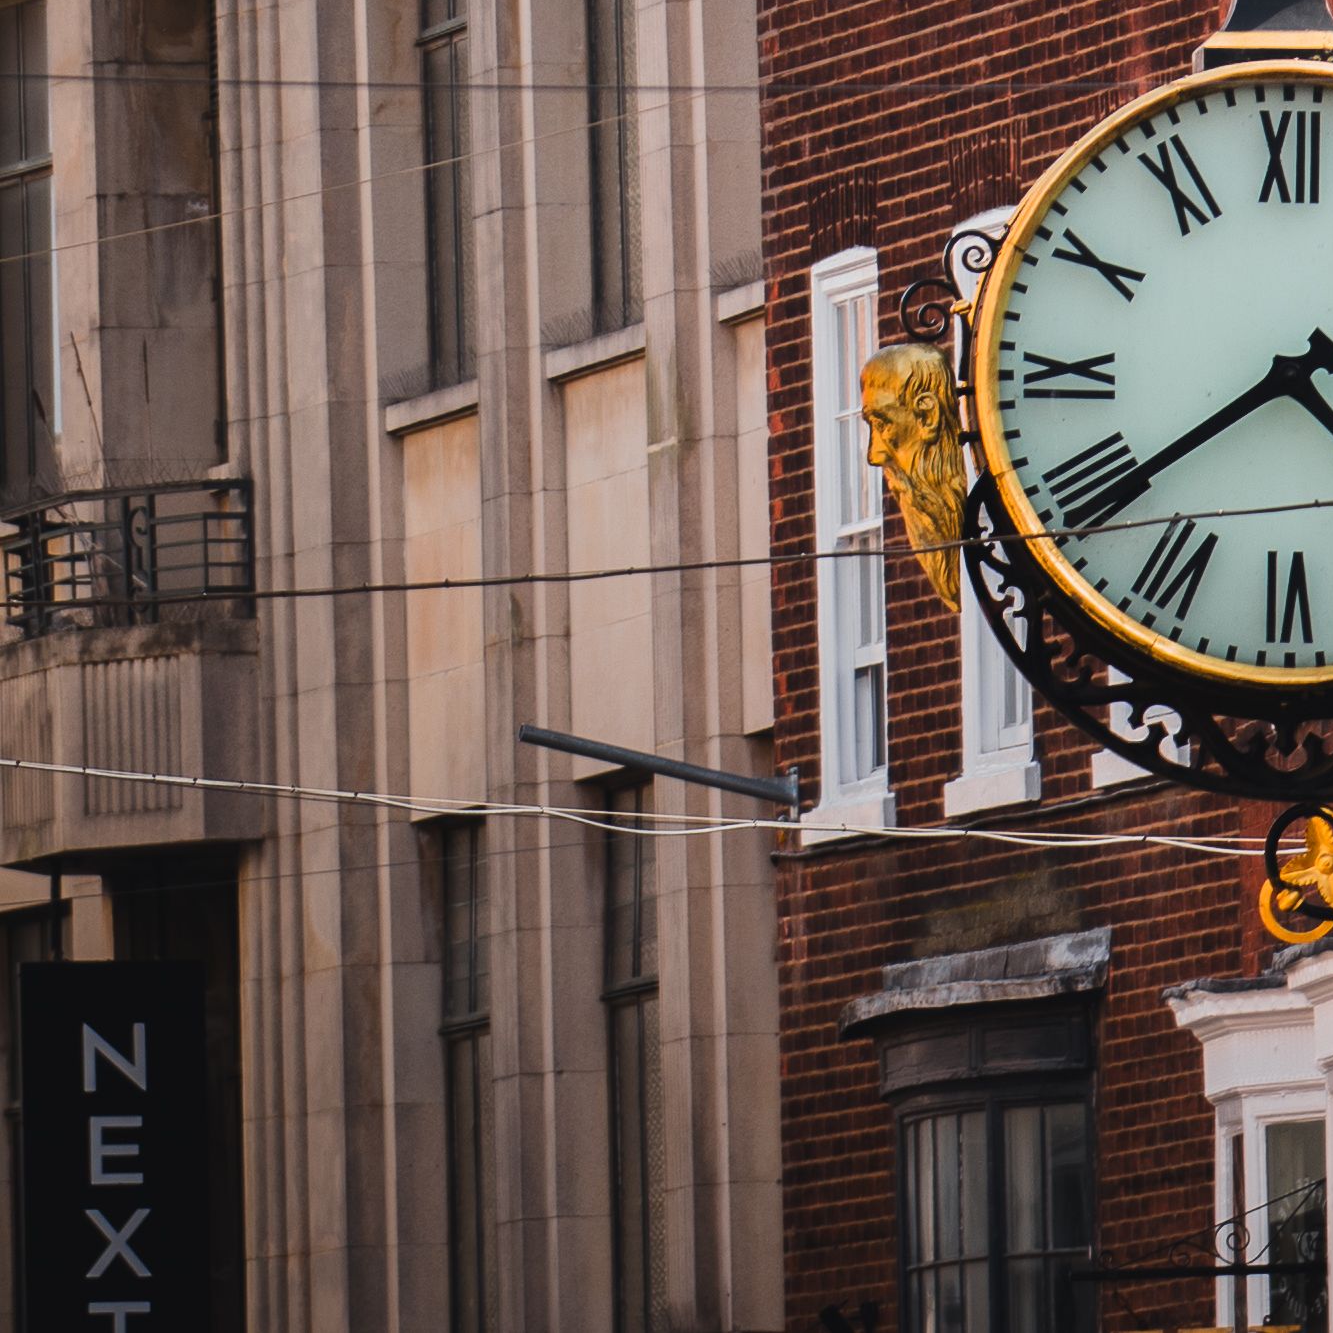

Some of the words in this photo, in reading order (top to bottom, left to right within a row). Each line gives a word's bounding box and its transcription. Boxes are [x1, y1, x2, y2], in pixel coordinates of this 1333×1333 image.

[1137, 134, 1222, 236] XI
[1258, 109, 1320, 204] XII
[1052, 227, 1146, 302] X
[1023, 352, 1115, 400] IX
[1131, 512, 1219, 621] VII
[1266, 550, 1314, 644] VI
